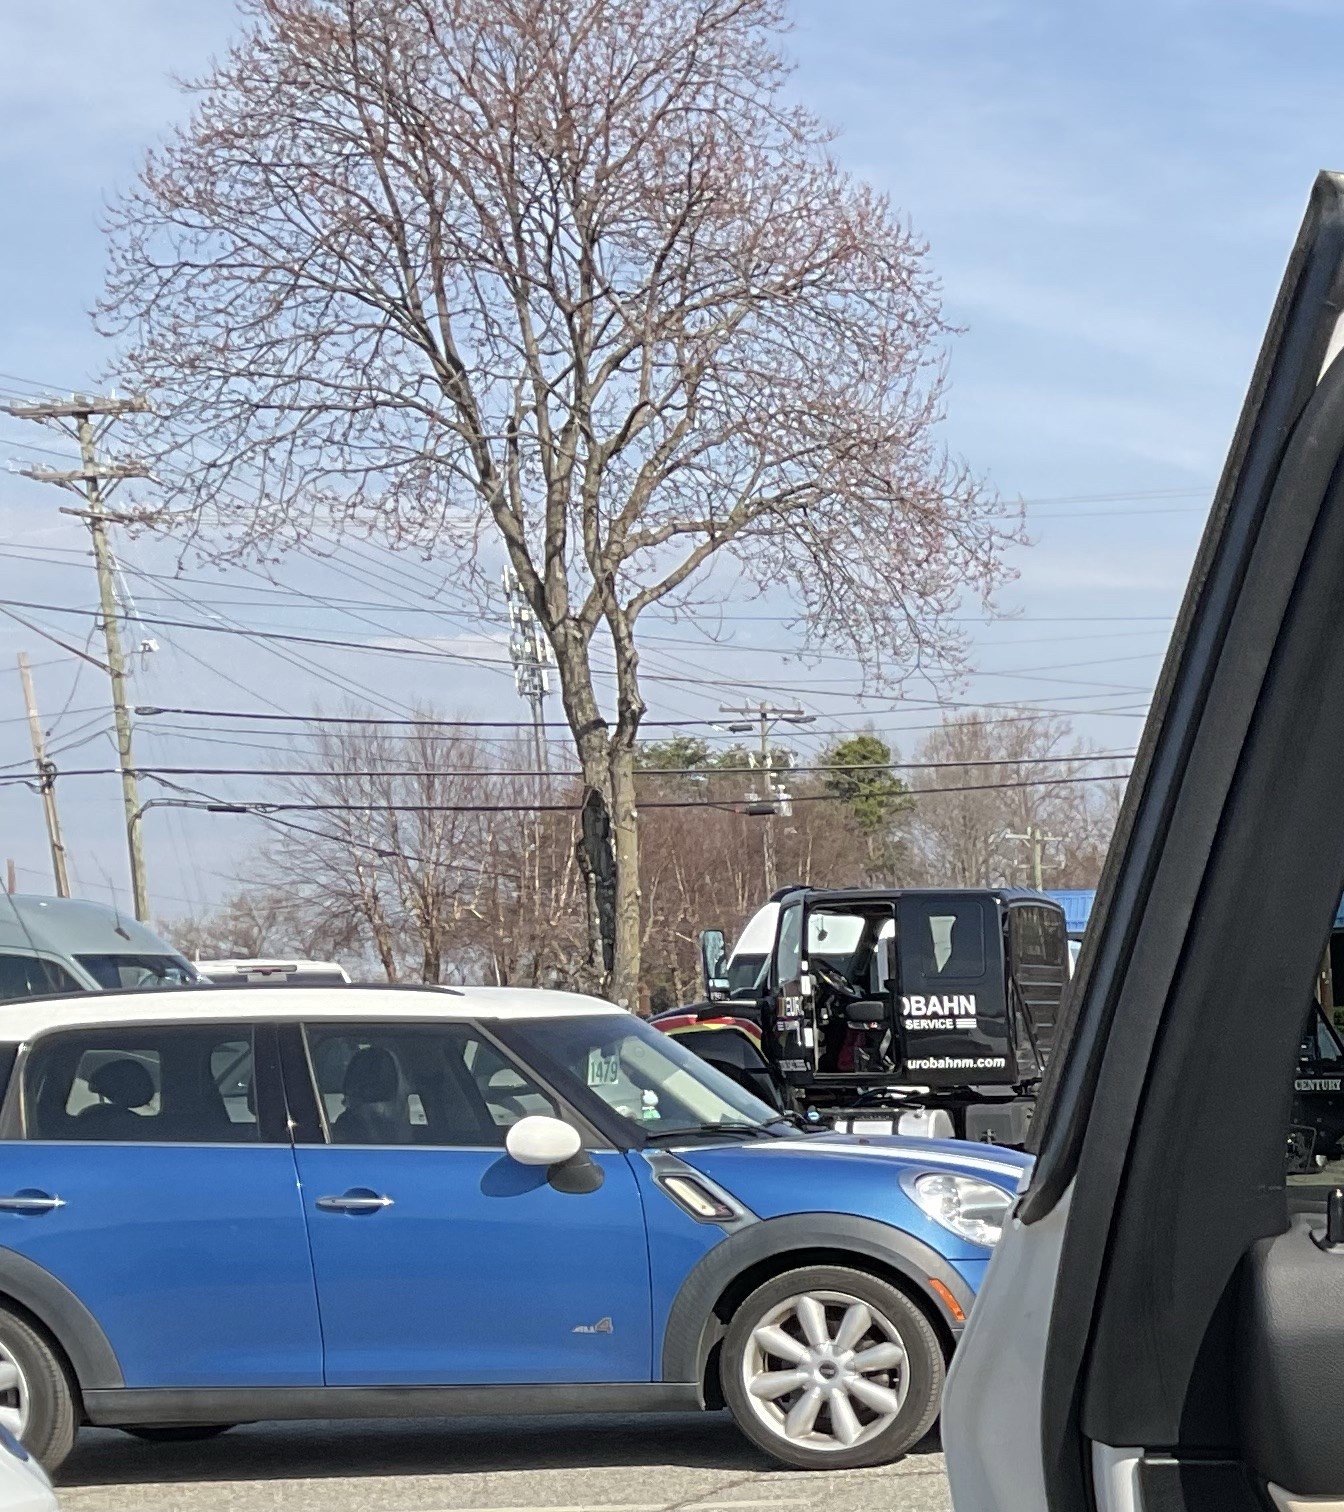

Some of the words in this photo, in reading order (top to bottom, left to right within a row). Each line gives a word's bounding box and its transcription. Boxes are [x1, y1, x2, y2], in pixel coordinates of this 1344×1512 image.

[905, 1018, 955, 1030] SERVICE
[907, 1056, 1006, 1069] urobahnm.com
[590, 1061, 618, 1083] 1479
[1294, 1078, 1342, 1091] CENTURY
